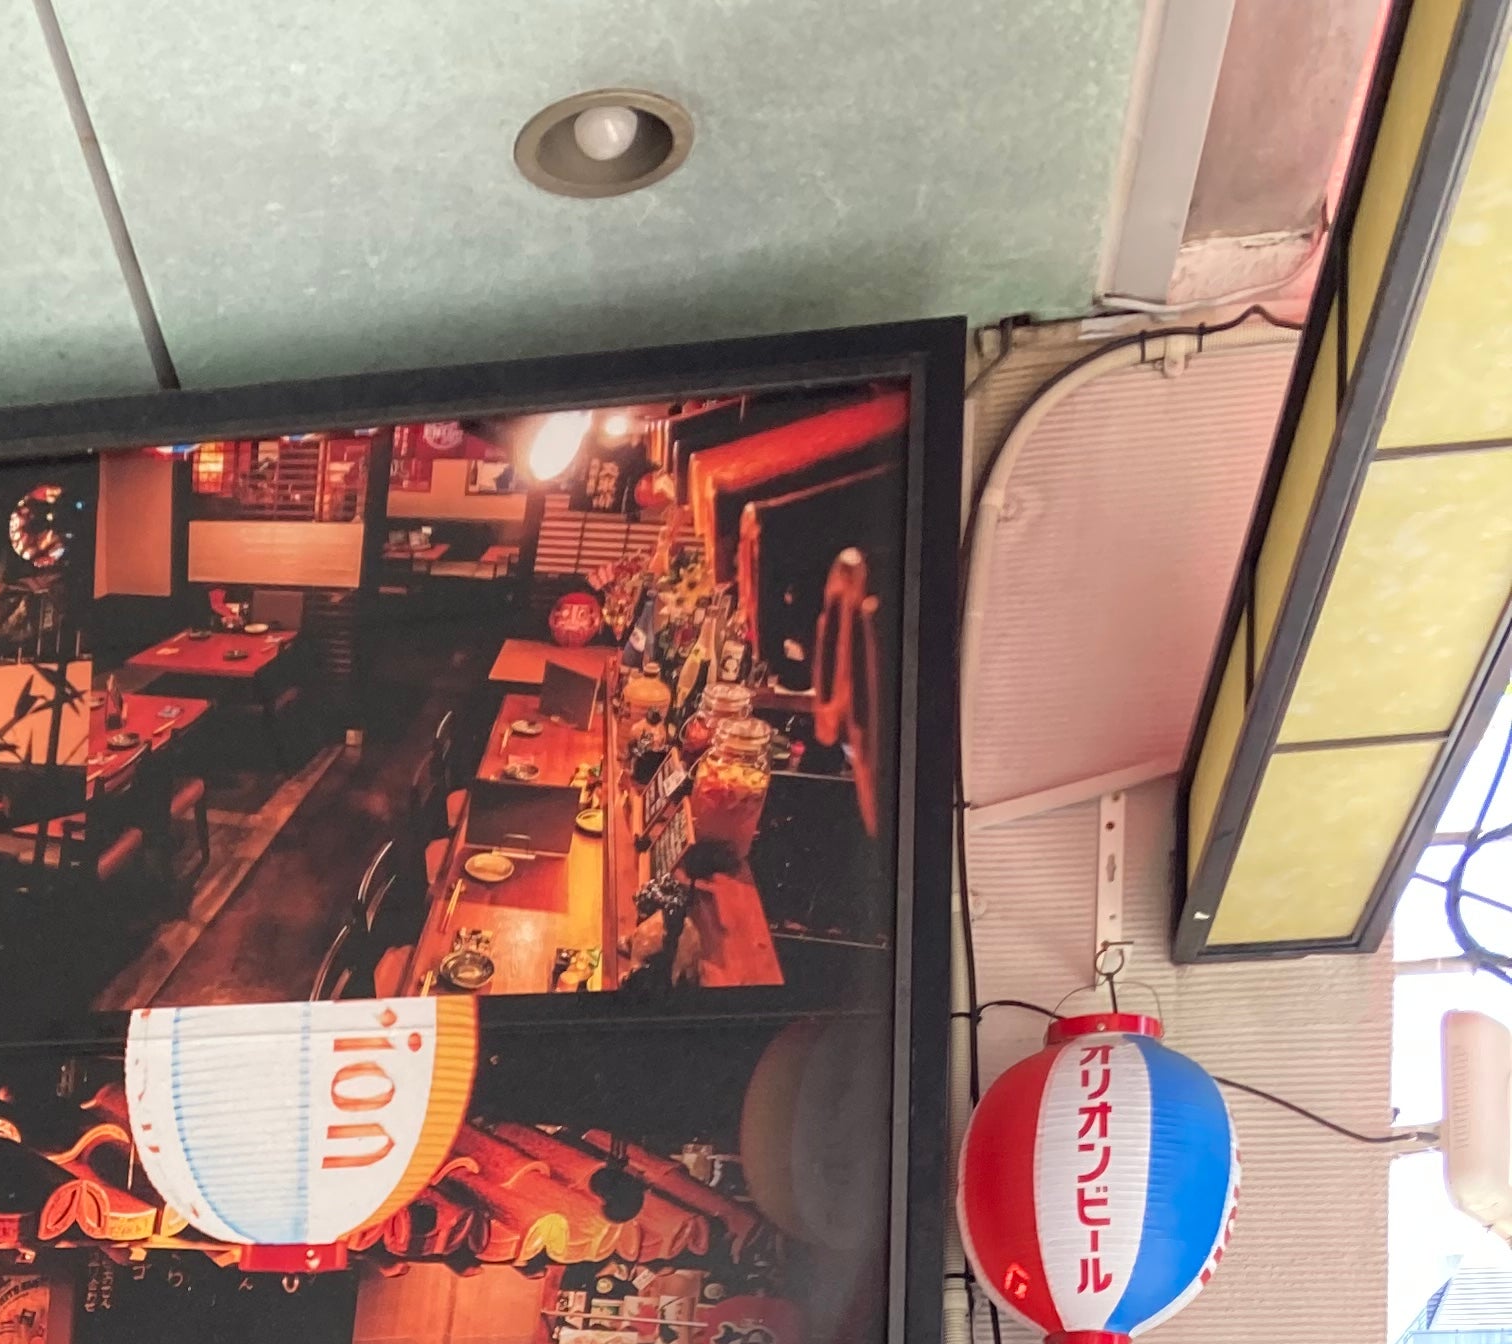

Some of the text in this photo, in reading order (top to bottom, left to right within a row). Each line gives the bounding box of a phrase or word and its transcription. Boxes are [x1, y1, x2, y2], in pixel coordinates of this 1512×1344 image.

[322, 1007, 423, 1169] ion
[1076, 1045, 1113, 1294] オリオンビール
